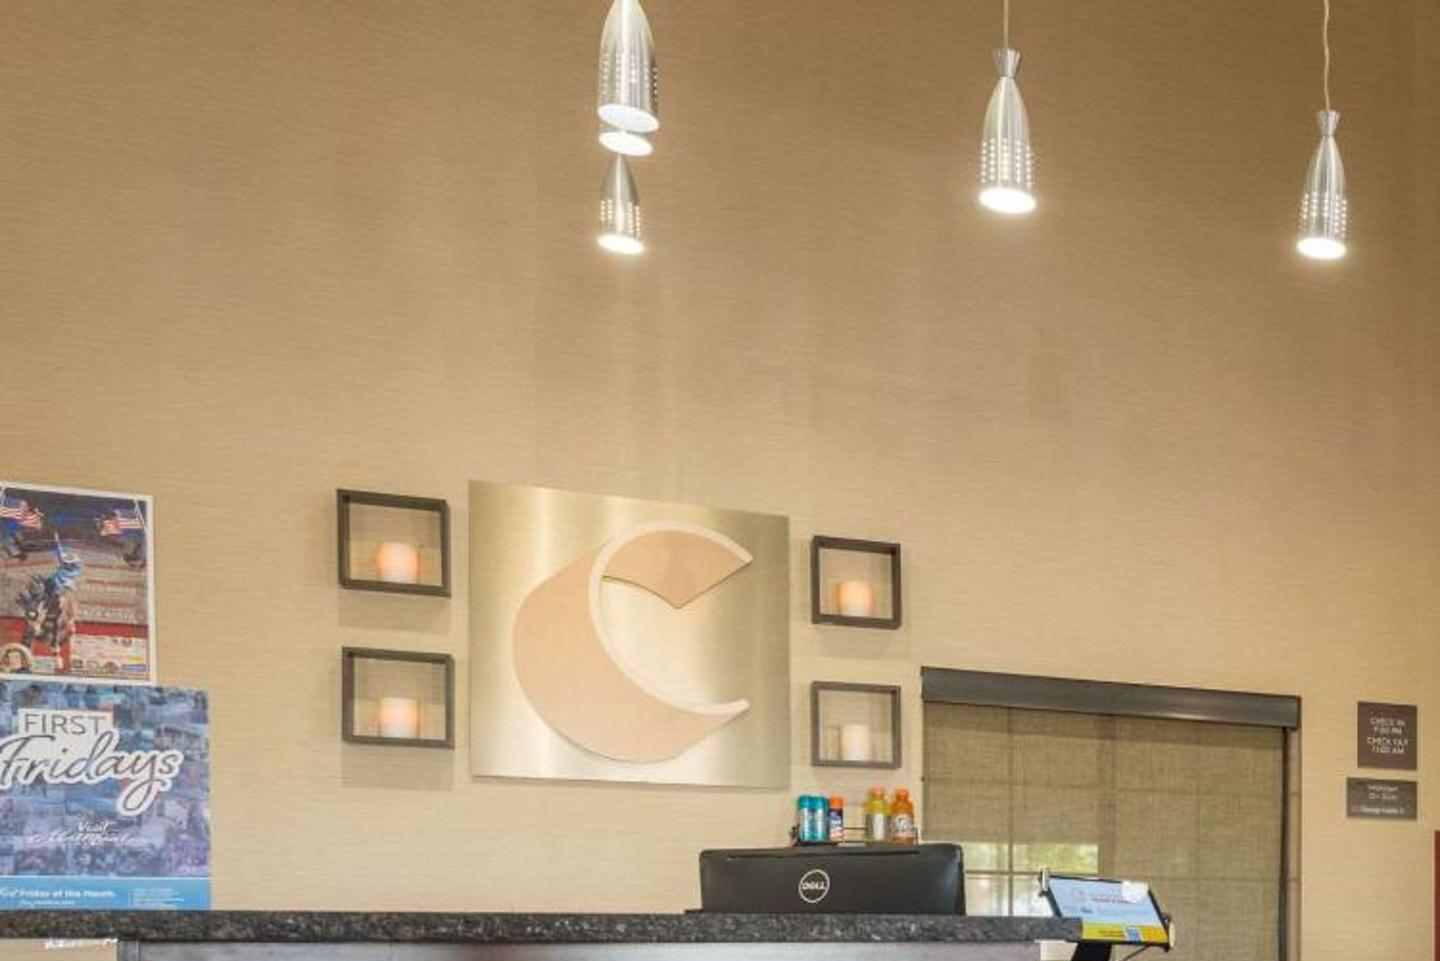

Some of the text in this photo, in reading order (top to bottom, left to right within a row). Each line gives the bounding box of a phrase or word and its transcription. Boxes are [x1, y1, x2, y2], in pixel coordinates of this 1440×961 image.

[24, 713, 106, 735] FIRST
[0, 730, 180, 811] Fridays
[802, 881, 825, 890] DELL
